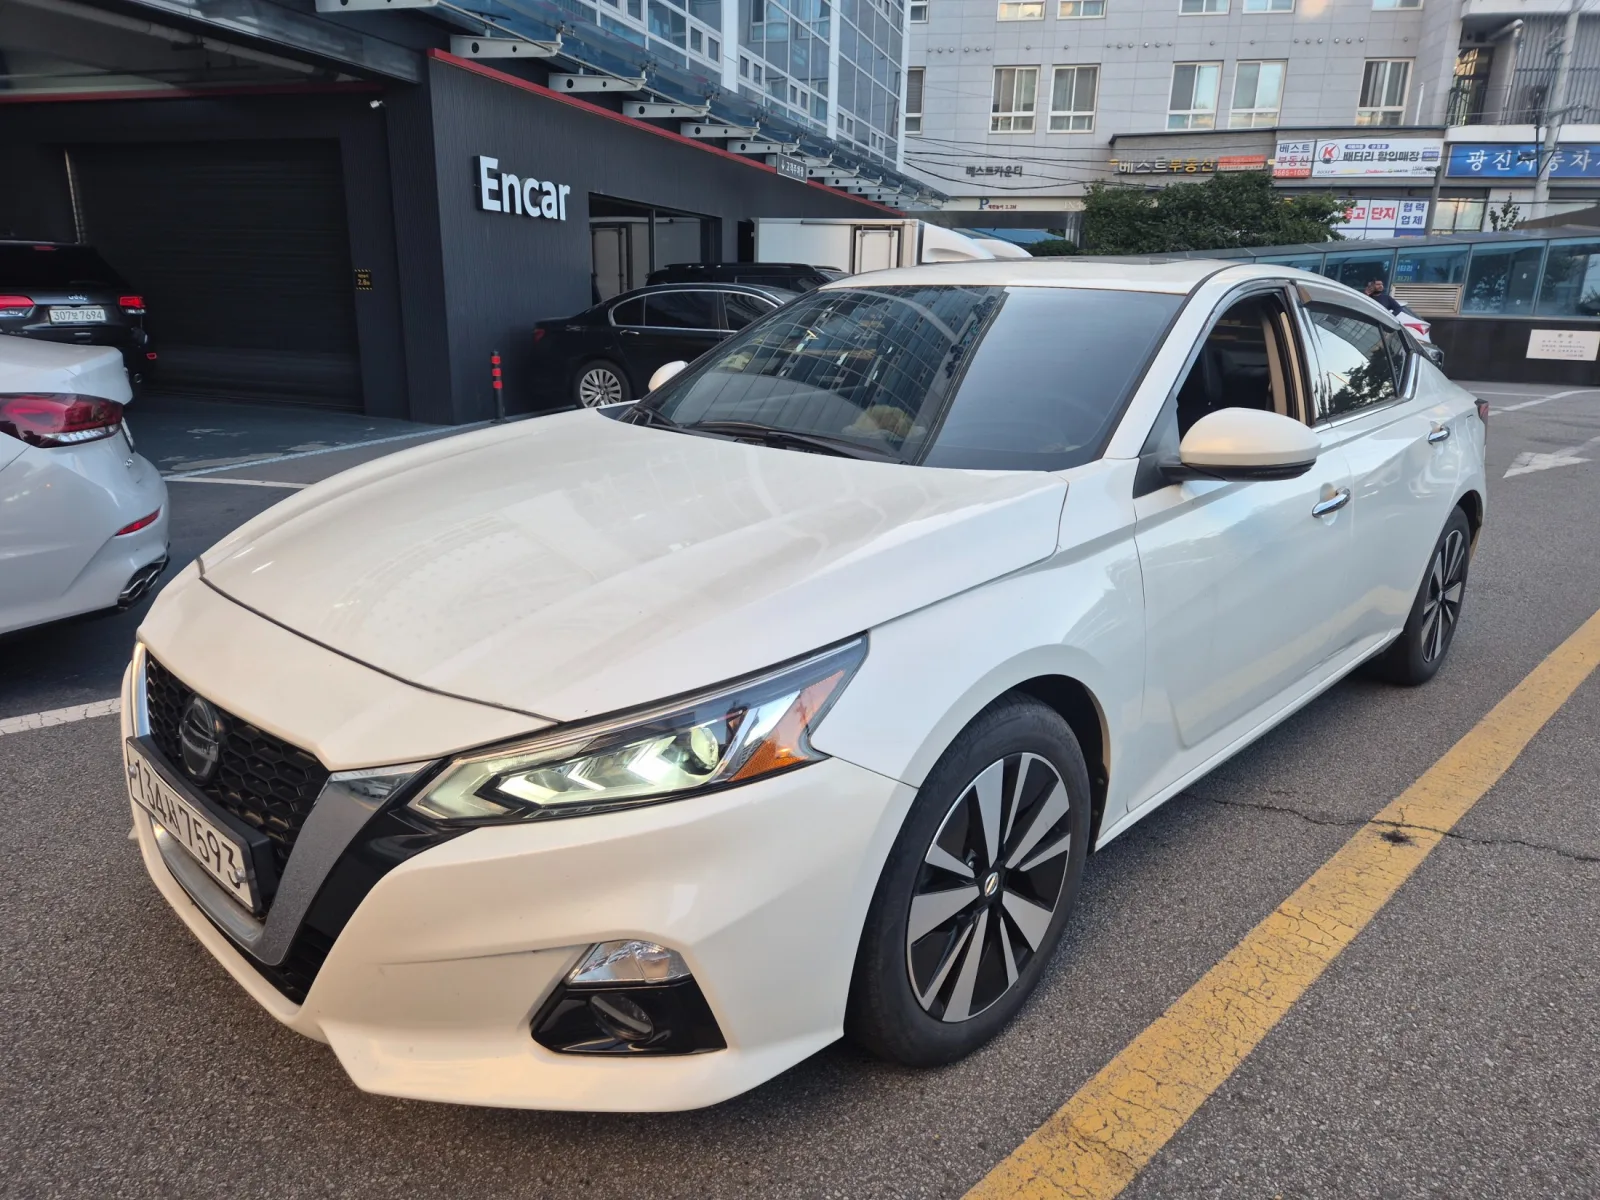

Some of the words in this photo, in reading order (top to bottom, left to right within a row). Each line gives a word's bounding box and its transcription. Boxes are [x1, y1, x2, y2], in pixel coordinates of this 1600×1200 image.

[1280, 143, 1310, 153] 베스트
[1277, 155, 1309, 167] 부동산
[1343, 151, 1374, 162] 배터리
[1378, 151, 1420, 162] 할인매장
[1466, 149, 1600, 172] 광진자동차
[966, 165, 1023, 178] 베스트카운티
[479, 155, 570, 221] Encar
[979, 198, 990, 210] P
[1371, 207, 1396, 220] 단지
